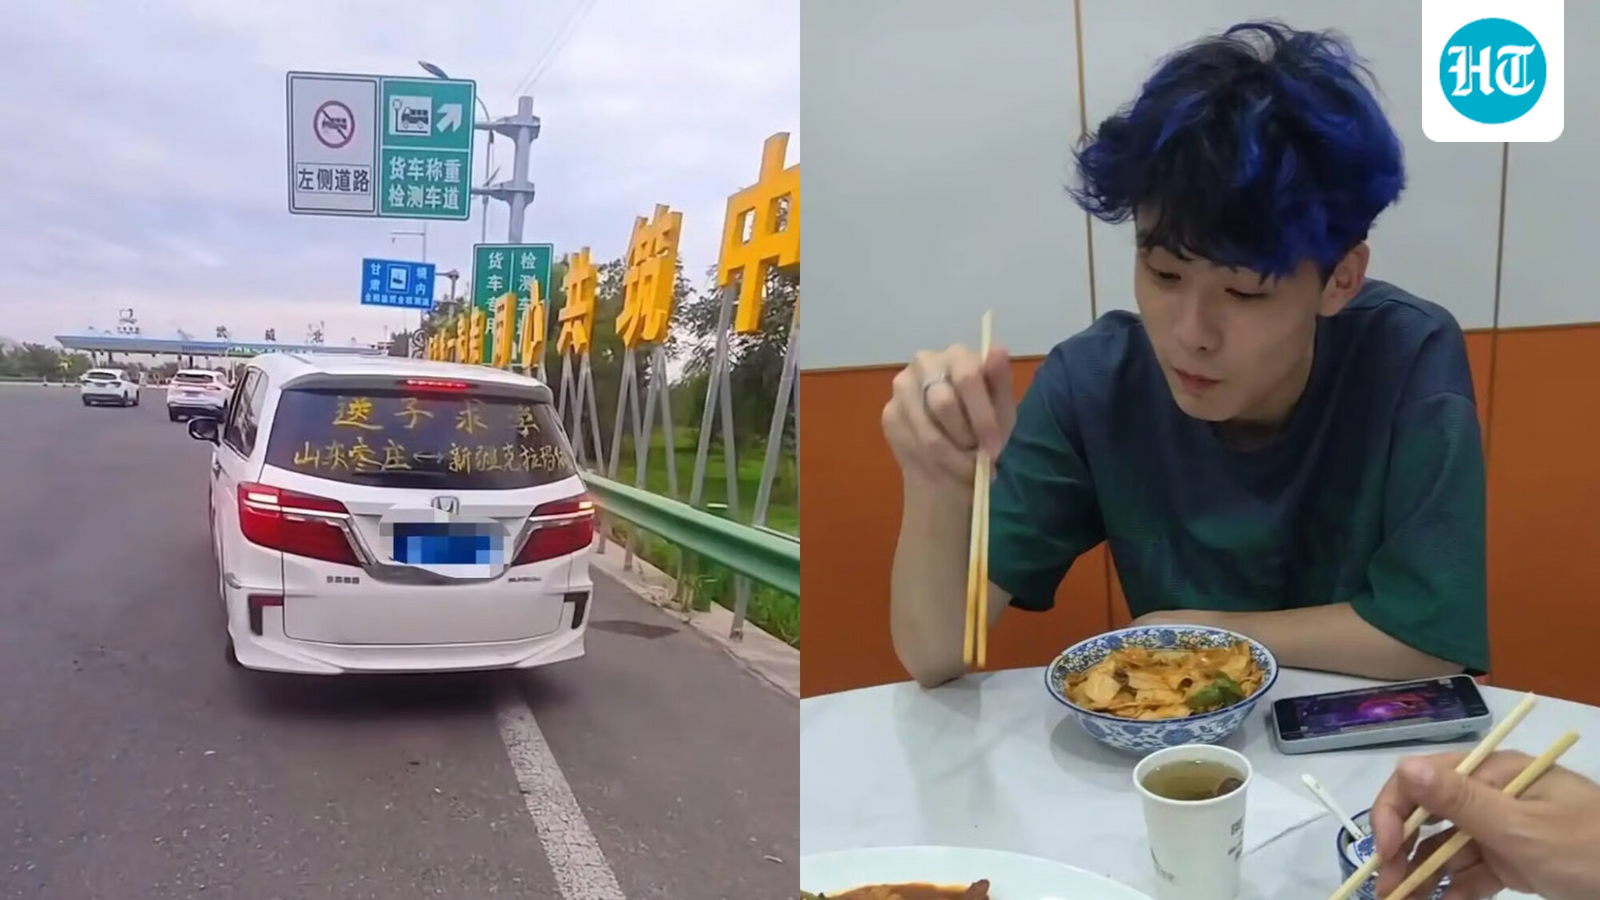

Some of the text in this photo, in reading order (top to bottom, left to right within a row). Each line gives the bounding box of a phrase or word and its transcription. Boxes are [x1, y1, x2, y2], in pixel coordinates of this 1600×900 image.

[298, 168, 370, 192] 左侧道路
[389, 156, 461, 183] 货车称重
[388, 185, 459, 210] 检测车道
